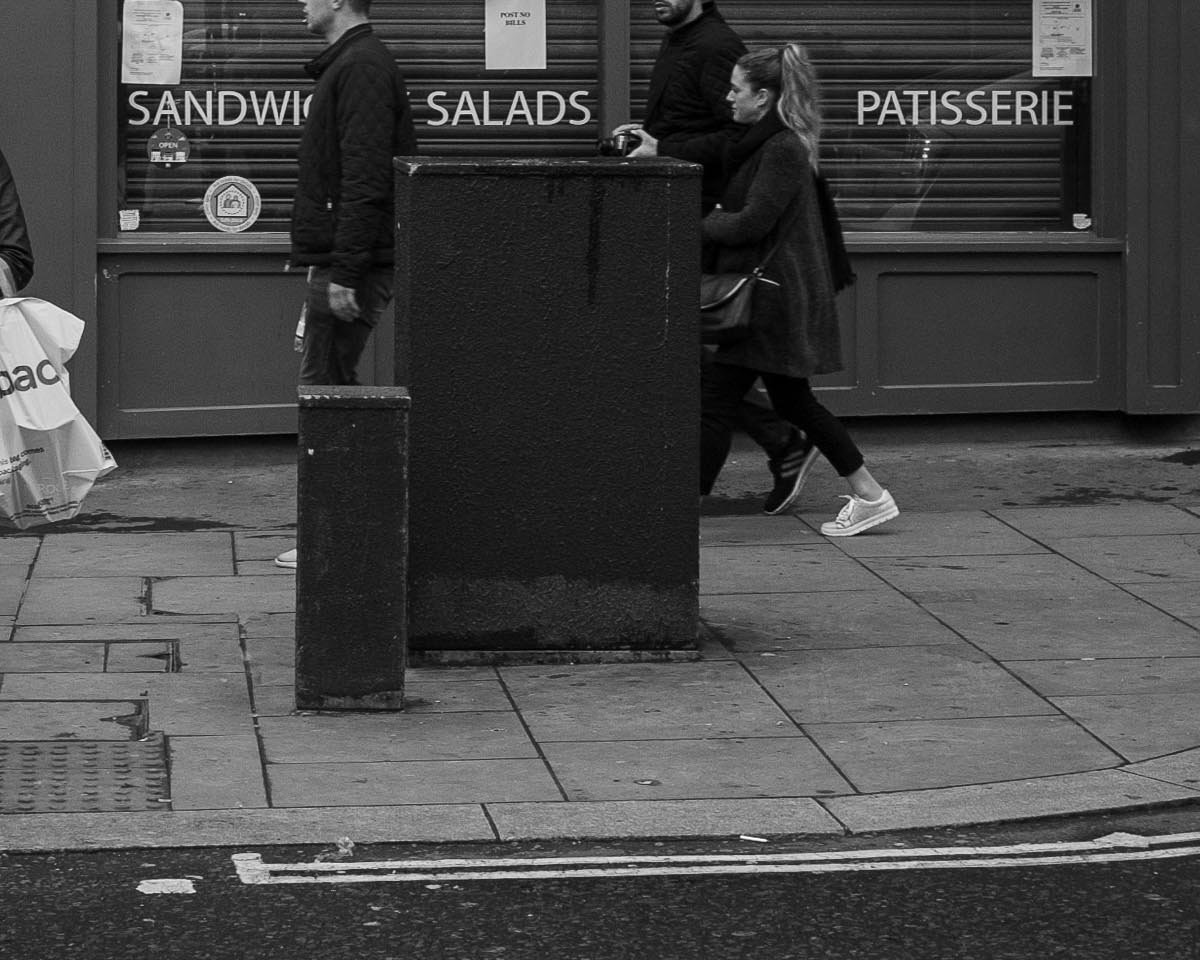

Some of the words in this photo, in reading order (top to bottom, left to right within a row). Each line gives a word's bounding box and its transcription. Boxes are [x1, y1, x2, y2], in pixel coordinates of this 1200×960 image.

[426, 90, 592, 127] SALADS
[857, 90, 1074, 126] PATISSERIE
[158, 141, 179, 150] OPEN
